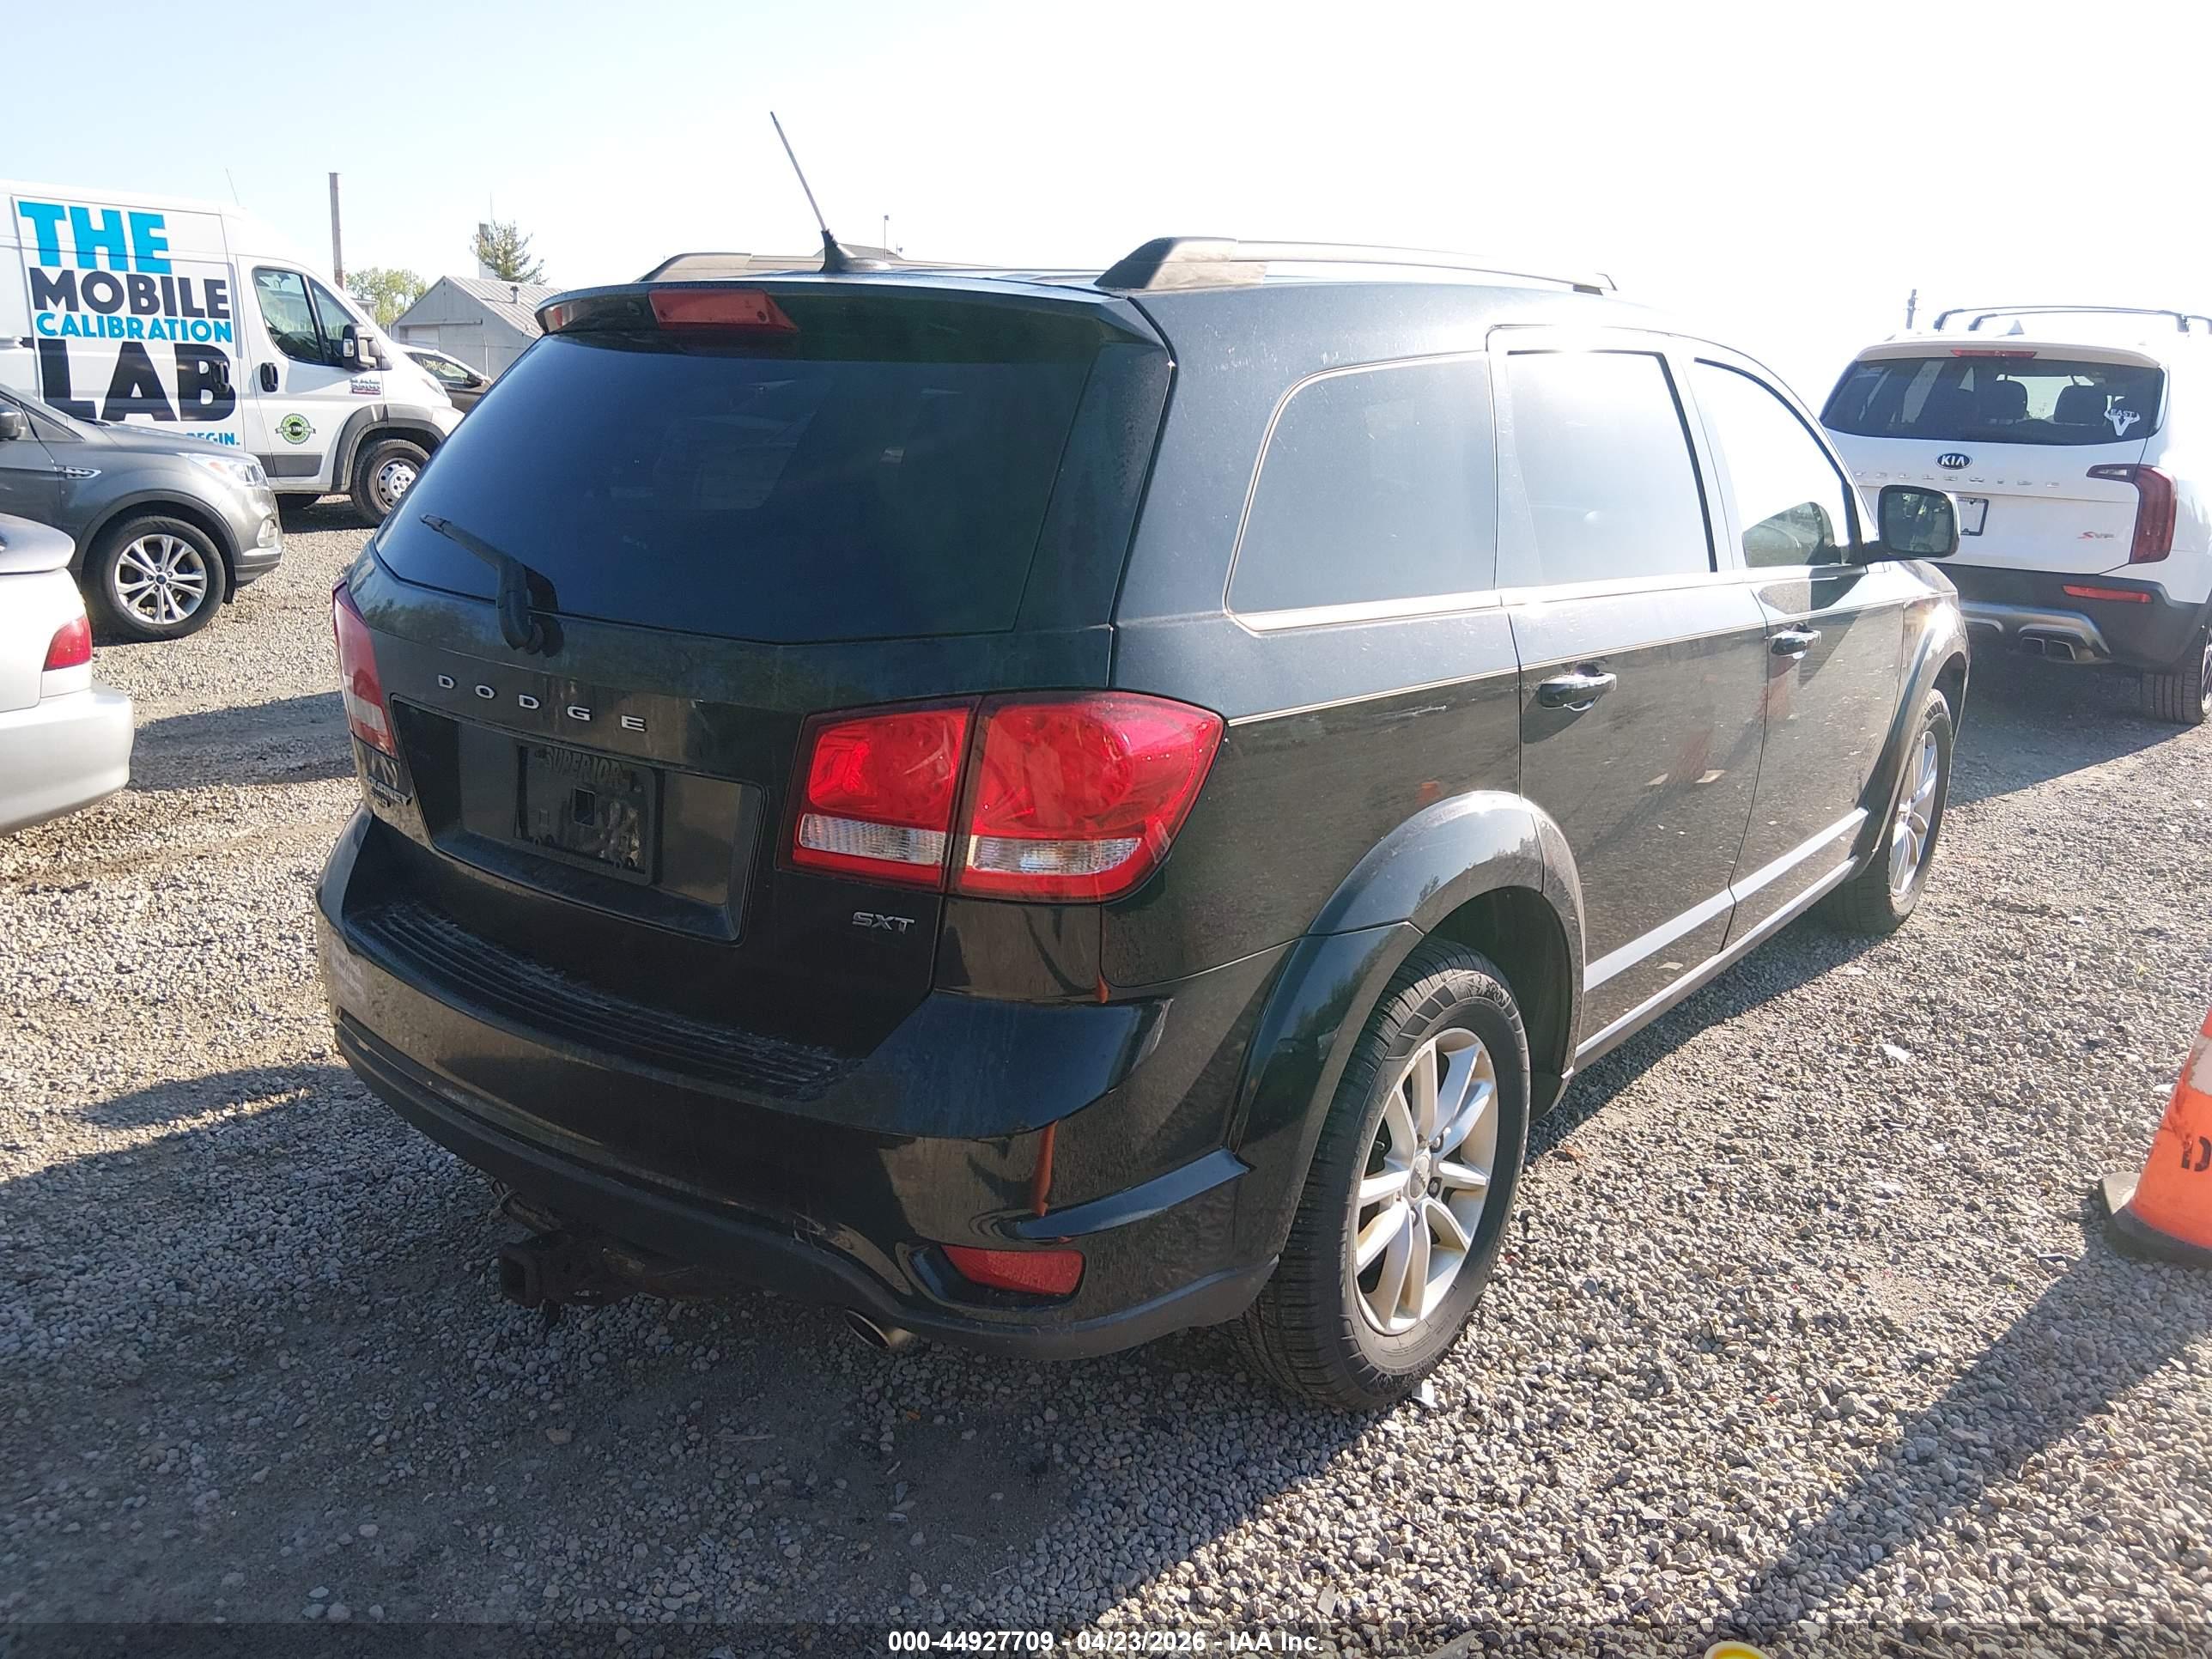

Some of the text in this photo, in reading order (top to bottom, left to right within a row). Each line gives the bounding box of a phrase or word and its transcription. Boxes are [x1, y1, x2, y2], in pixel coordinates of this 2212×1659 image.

[18, 201, 172, 275] THE
[28, 267, 230, 319] MOBILE
[36, 313, 233, 343] CALIBRATION
[38, 338, 236, 422] LAB
[1941, 455, 1966, 466] KIA
[437, 674, 646, 732] DODGE
[852, 911, 915, 935] SXT
